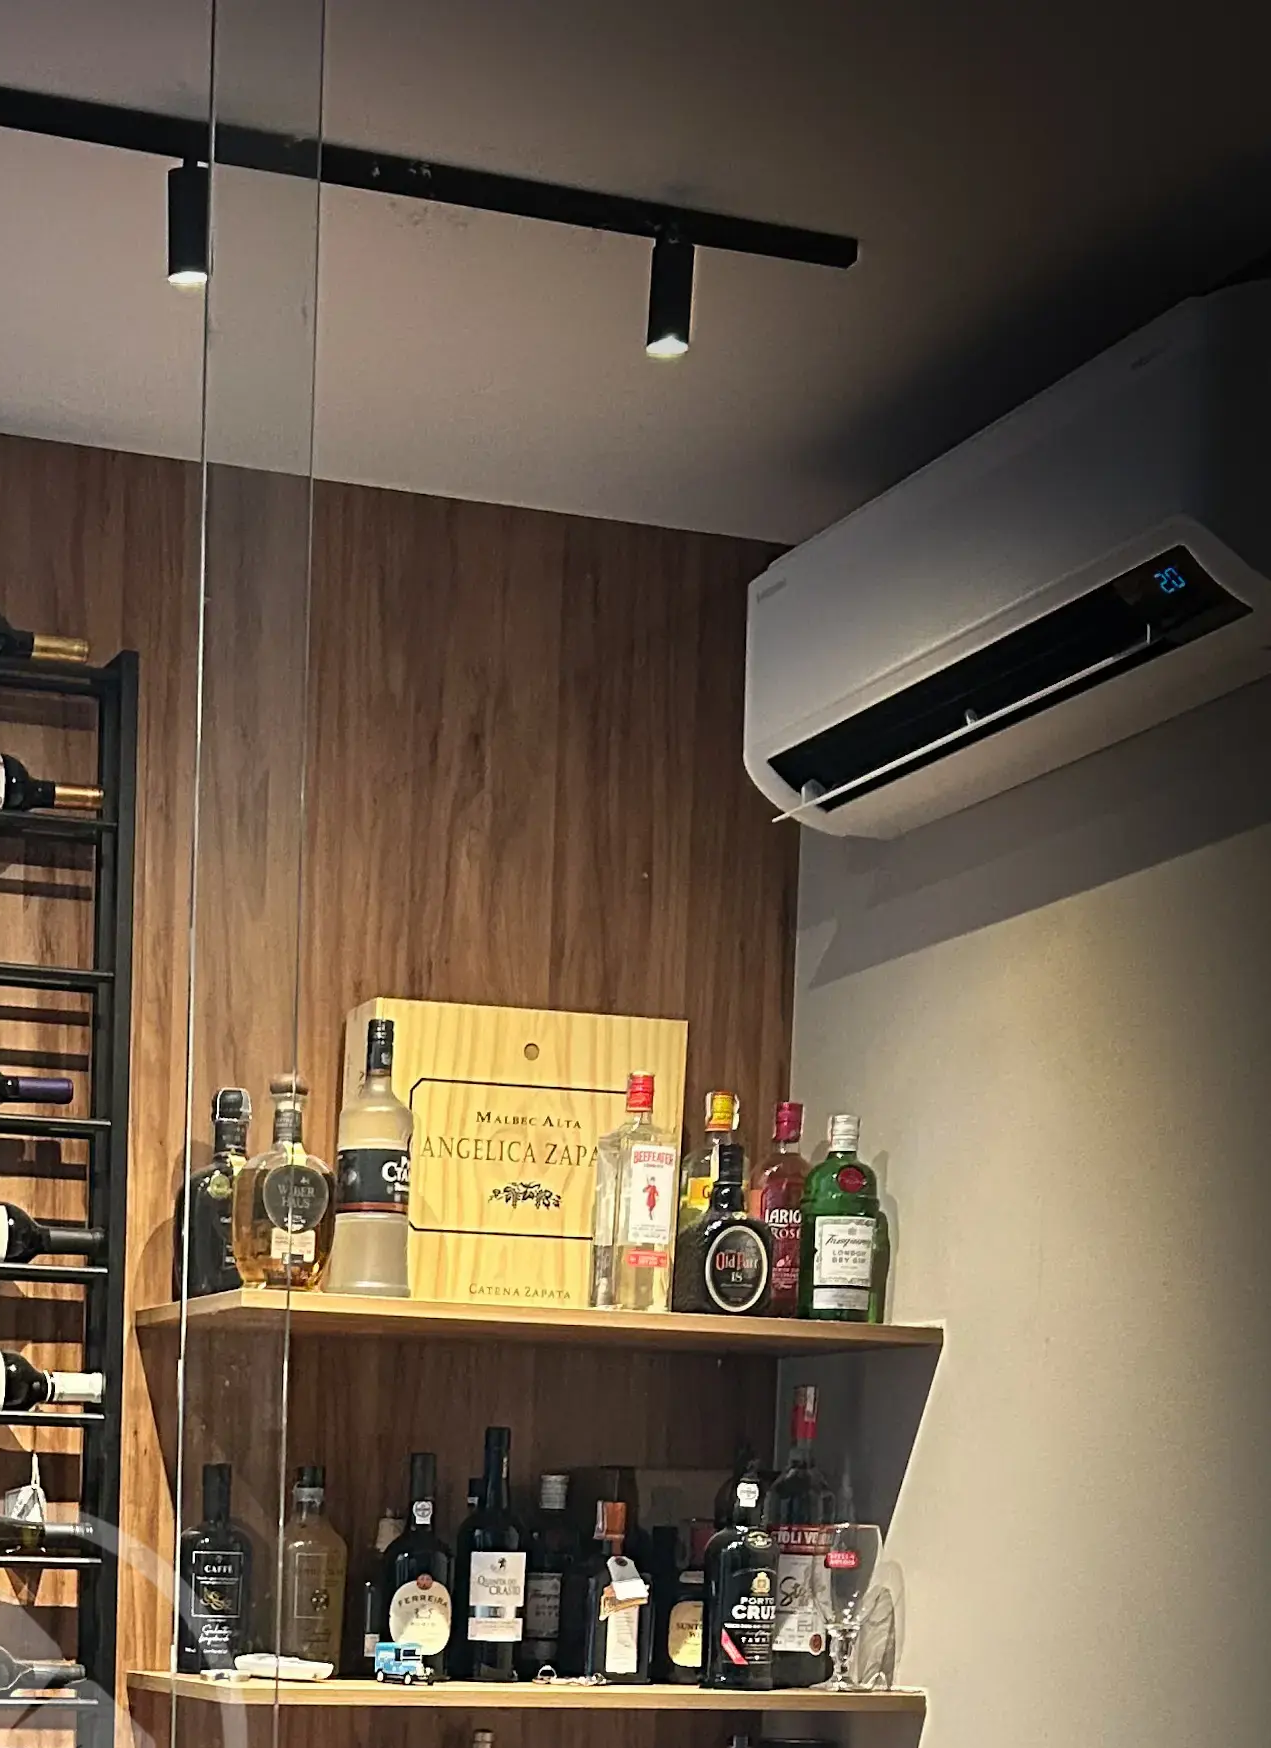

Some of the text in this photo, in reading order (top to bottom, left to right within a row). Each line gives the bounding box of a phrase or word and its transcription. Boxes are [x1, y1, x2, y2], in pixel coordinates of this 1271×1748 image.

[1153, 567, 1186, 594] 20
[475, 1111, 582, 1129] MALBEC ALTA
[420, 1135, 599, 1168] ANGELICA ZAPA
[633, 1150, 674, 1167] BEEFEATER
[764, 1208, 802, 1225] LARIO
[715, 1252, 759, 1271] Old Parr
[469, 1283, 571, 1300] CATENA ZAPATA
[397, 1594, 449, 1608] FERREIRA
[675, 1622, 703, 1632] SUNT
